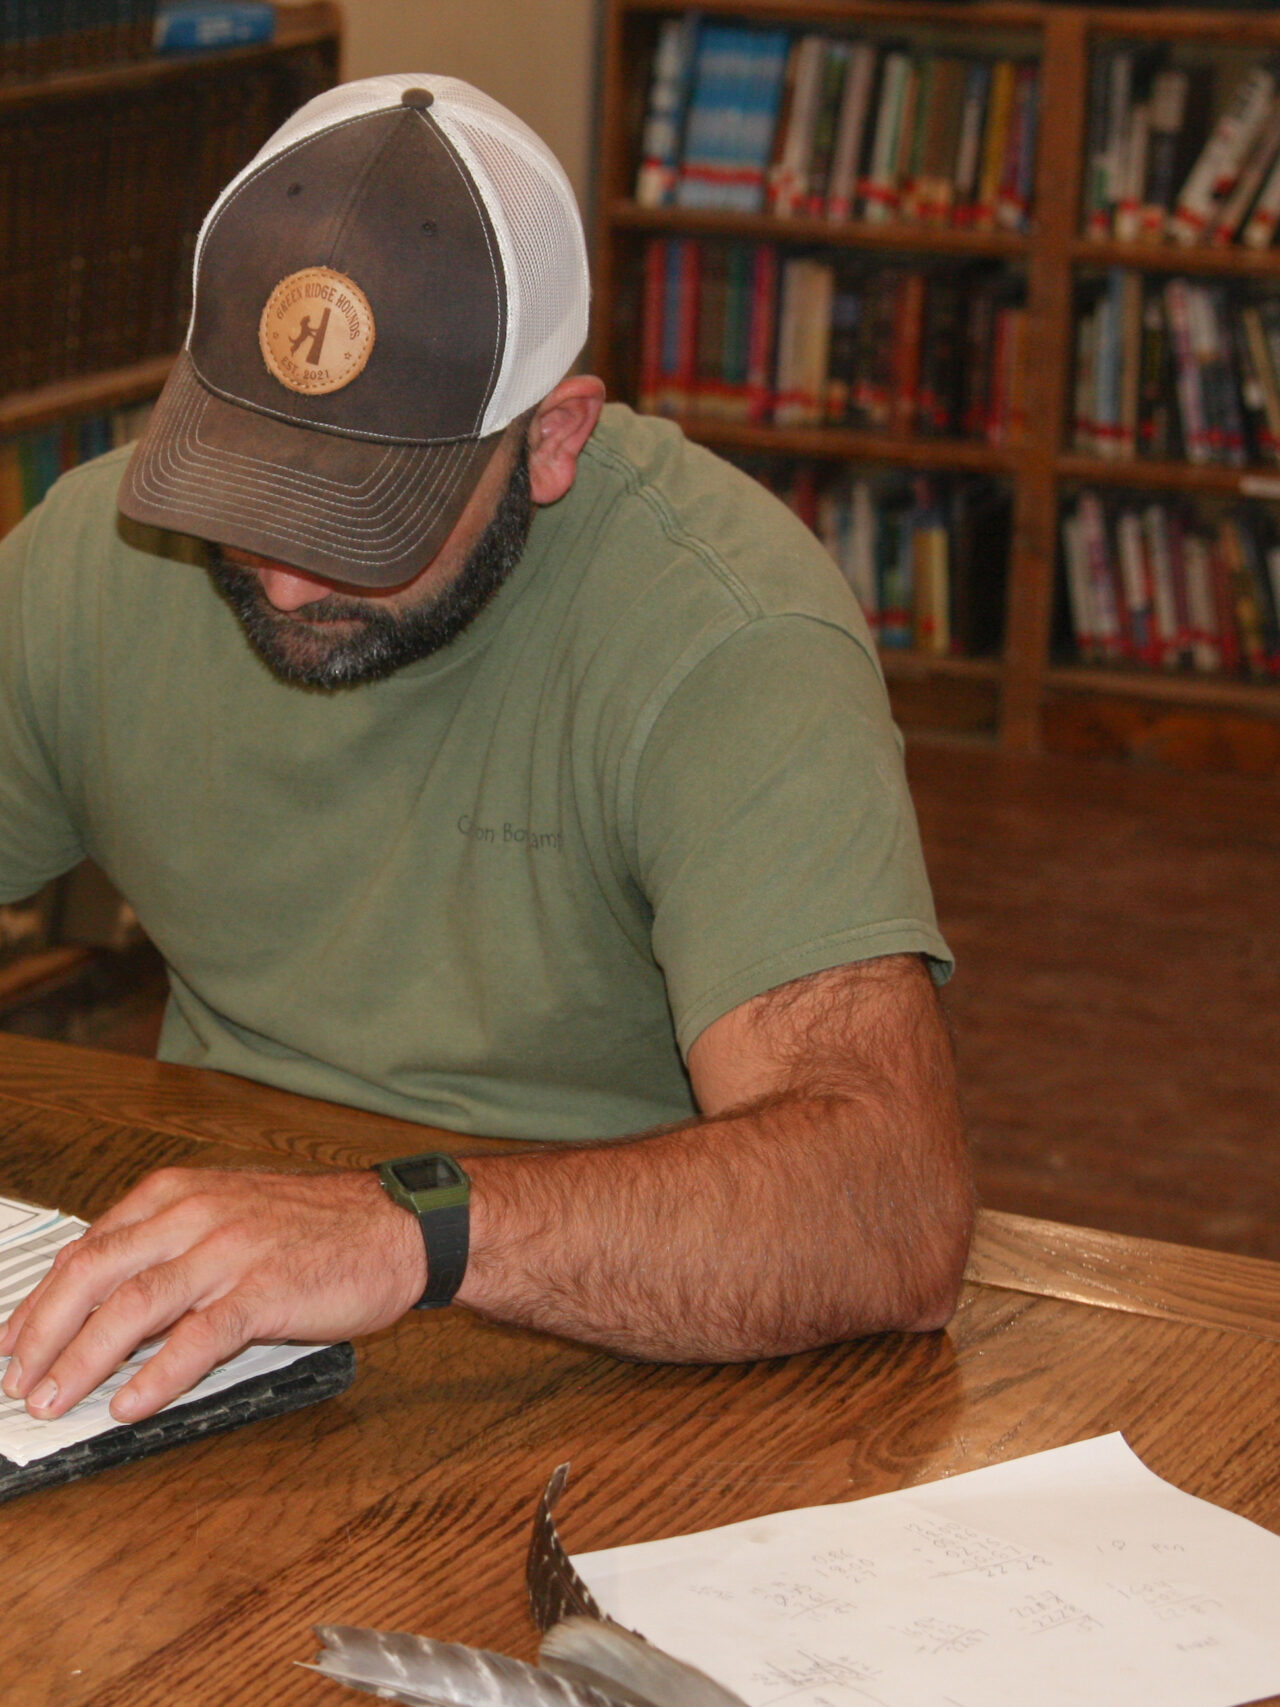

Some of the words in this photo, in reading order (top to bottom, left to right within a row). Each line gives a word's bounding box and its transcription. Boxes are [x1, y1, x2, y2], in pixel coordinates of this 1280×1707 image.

[276, 288, 303, 320] GREEN
[304, 282, 338, 303] RIDGE
[335, 293, 360, 340] HOUNDS
[303, 369, 330, 380] 2021
